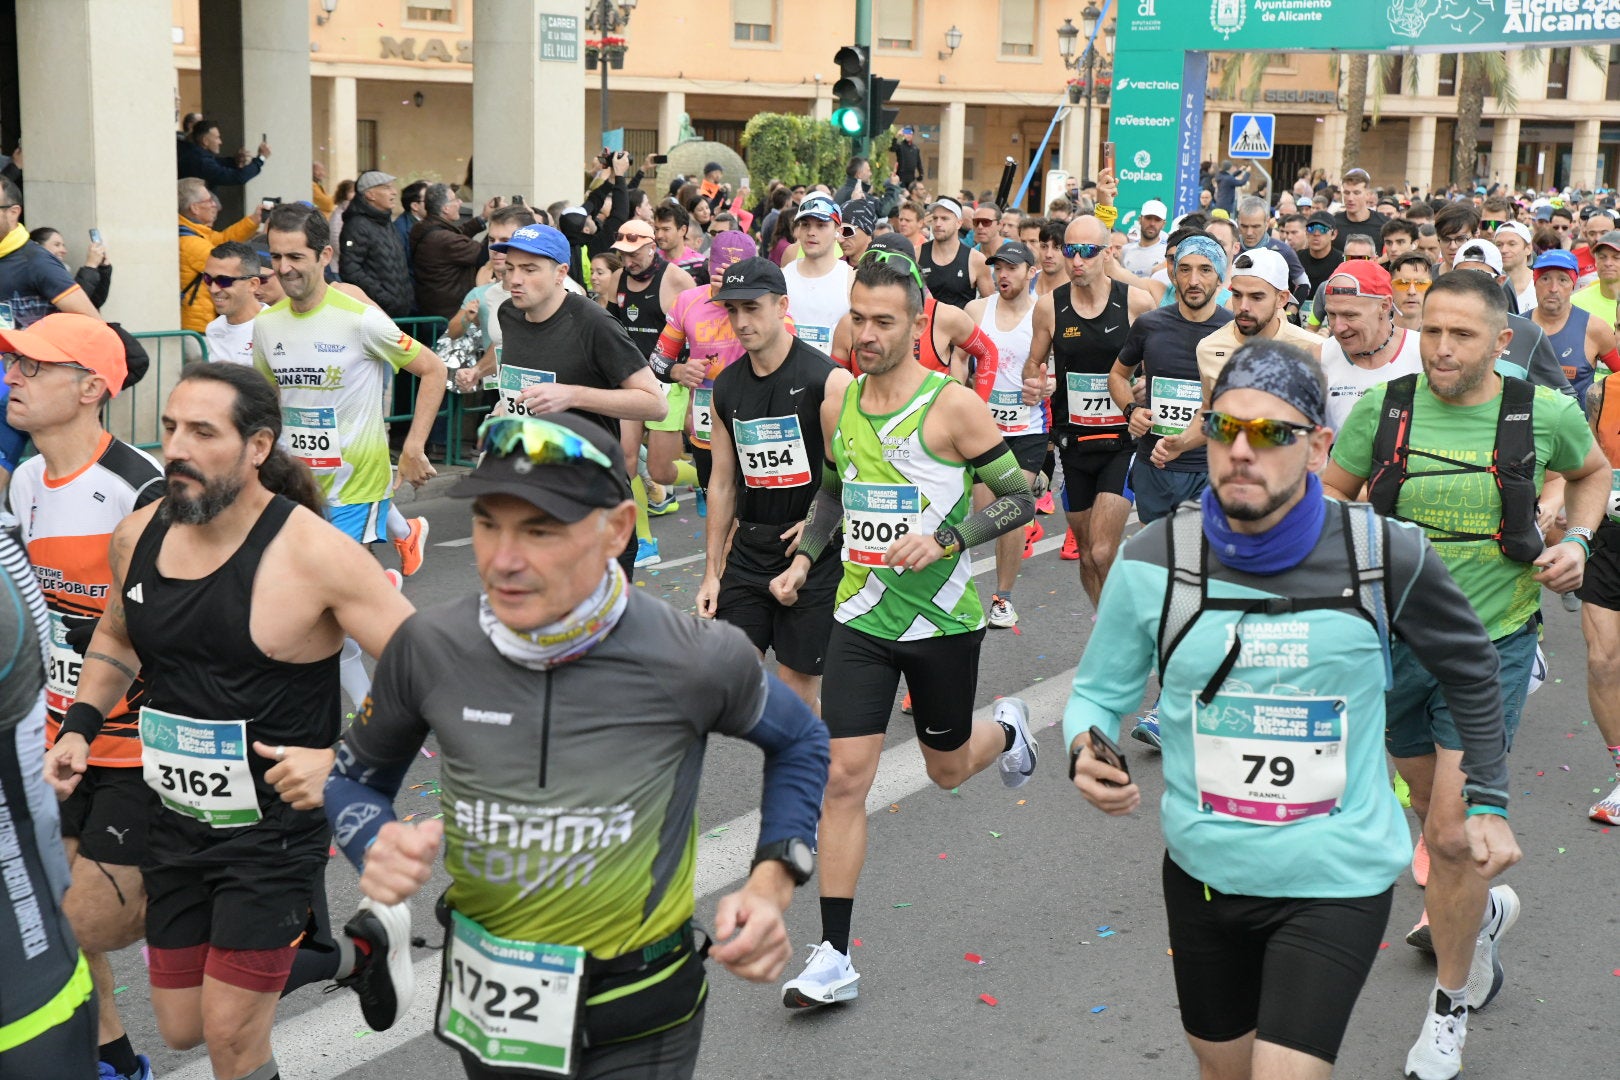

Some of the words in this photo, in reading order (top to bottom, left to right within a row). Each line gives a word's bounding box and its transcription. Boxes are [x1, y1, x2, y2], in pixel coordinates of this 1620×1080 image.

[1254, 0, 1332, 11] Ayuntamiento
[1504, 0, 1579, 15] Elche
[548, 17, 576, 29] CARRER
[1262, 12, 1276, 21] de
[1278, 11, 1323, 21] Alicante
[1502, 8, 1620, 33] Alicante
[544, 43, 555, 57] DEL
[1120, 169, 1163, 183] Coplaca
[303, 375, 321, 386] TRI
[1083, 398, 1111, 411] 771
[291, 433, 330, 450] 2630
[746, 449, 794, 469] 3154
[1425, 508, 1459, 518] PROVA
[1464, 510, 1493, 520] LLIGA
[1463, 519, 1489, 528] OPEN
[851, 520, 909, 543] 3008
[43, 578, 56, 590] DE
[58, 581, 108, 598] POBLET
[1244, 620, 1310, 633] MARATÓN
[1225, 640, 1279, 655] Eche
[1281, 643, 1309, 655] 42K
[1266, 705, 1309, 716] MARATÓN
[1253, 716, 1287, 728] Elche
[1289, 720, 1308, 729] 42K
[1253, 726, 1308, 737] Alicante
[1242, 754, 1295, 787] 79
[158, 764, 232, 797] 3162
[2, 856, 34, 901] PUERTO
[12, 894, 50, 961] TORREVIEJA
[454, 959, 540, 1022] 1722
